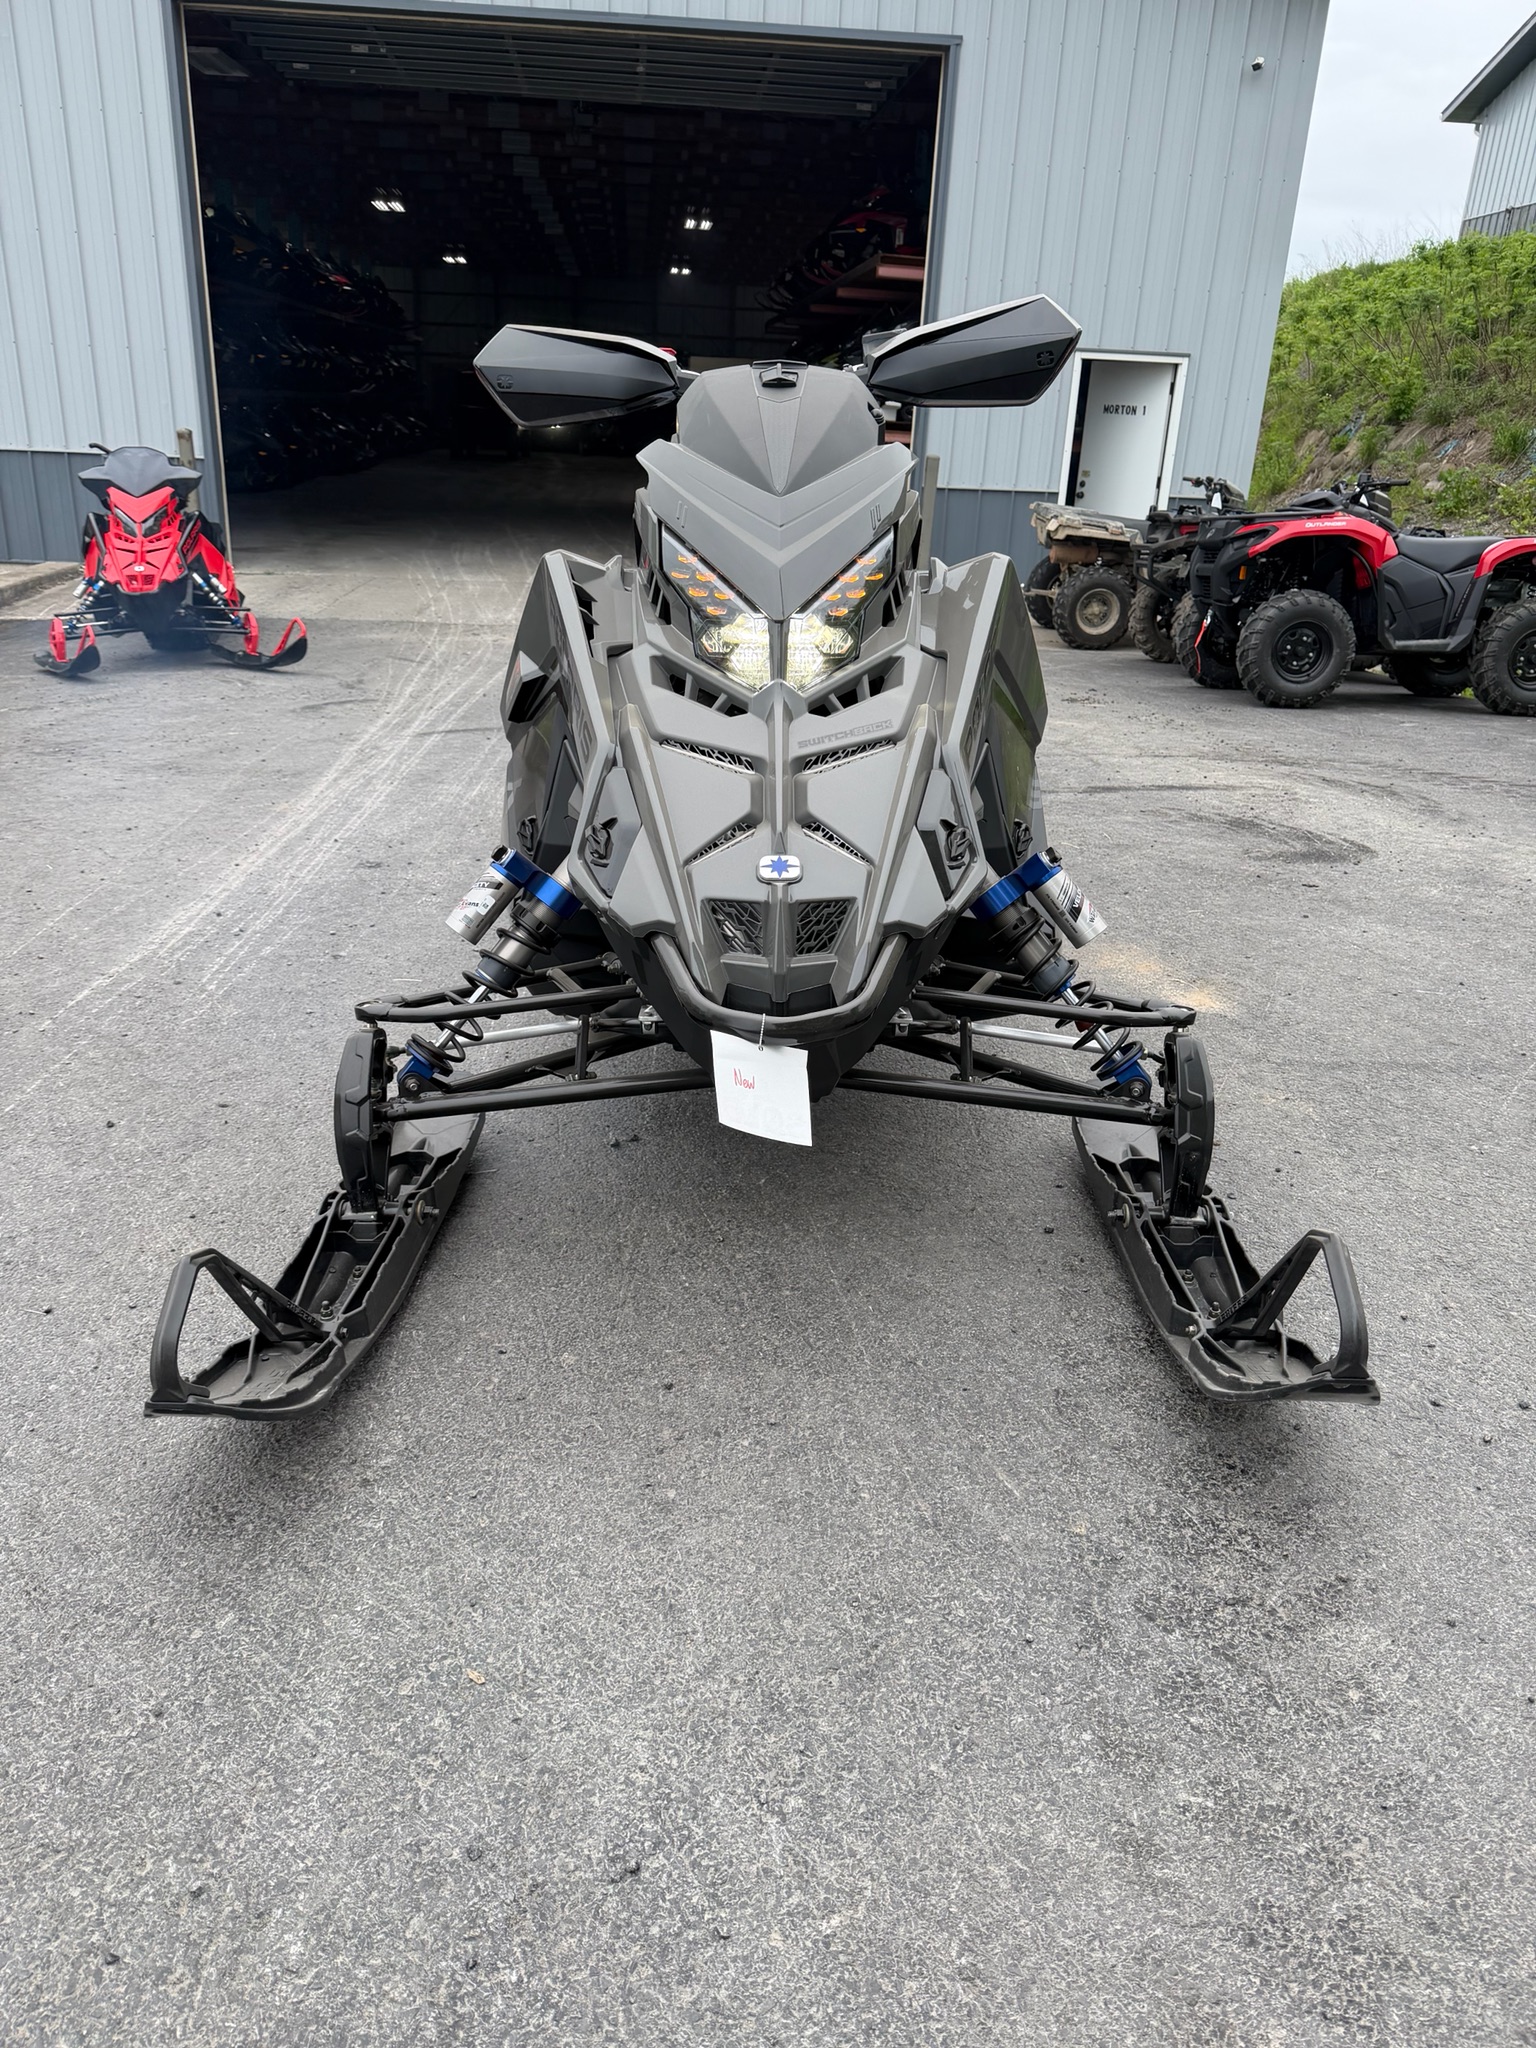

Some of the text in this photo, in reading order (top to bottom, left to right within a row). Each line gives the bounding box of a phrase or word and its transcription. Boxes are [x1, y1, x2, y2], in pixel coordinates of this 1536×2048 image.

[1103, 404, 1147, 416] MORTON 1
[797, 719, 894, 749] SWITCHBACK
[733, 1067, 755, 1090] New
